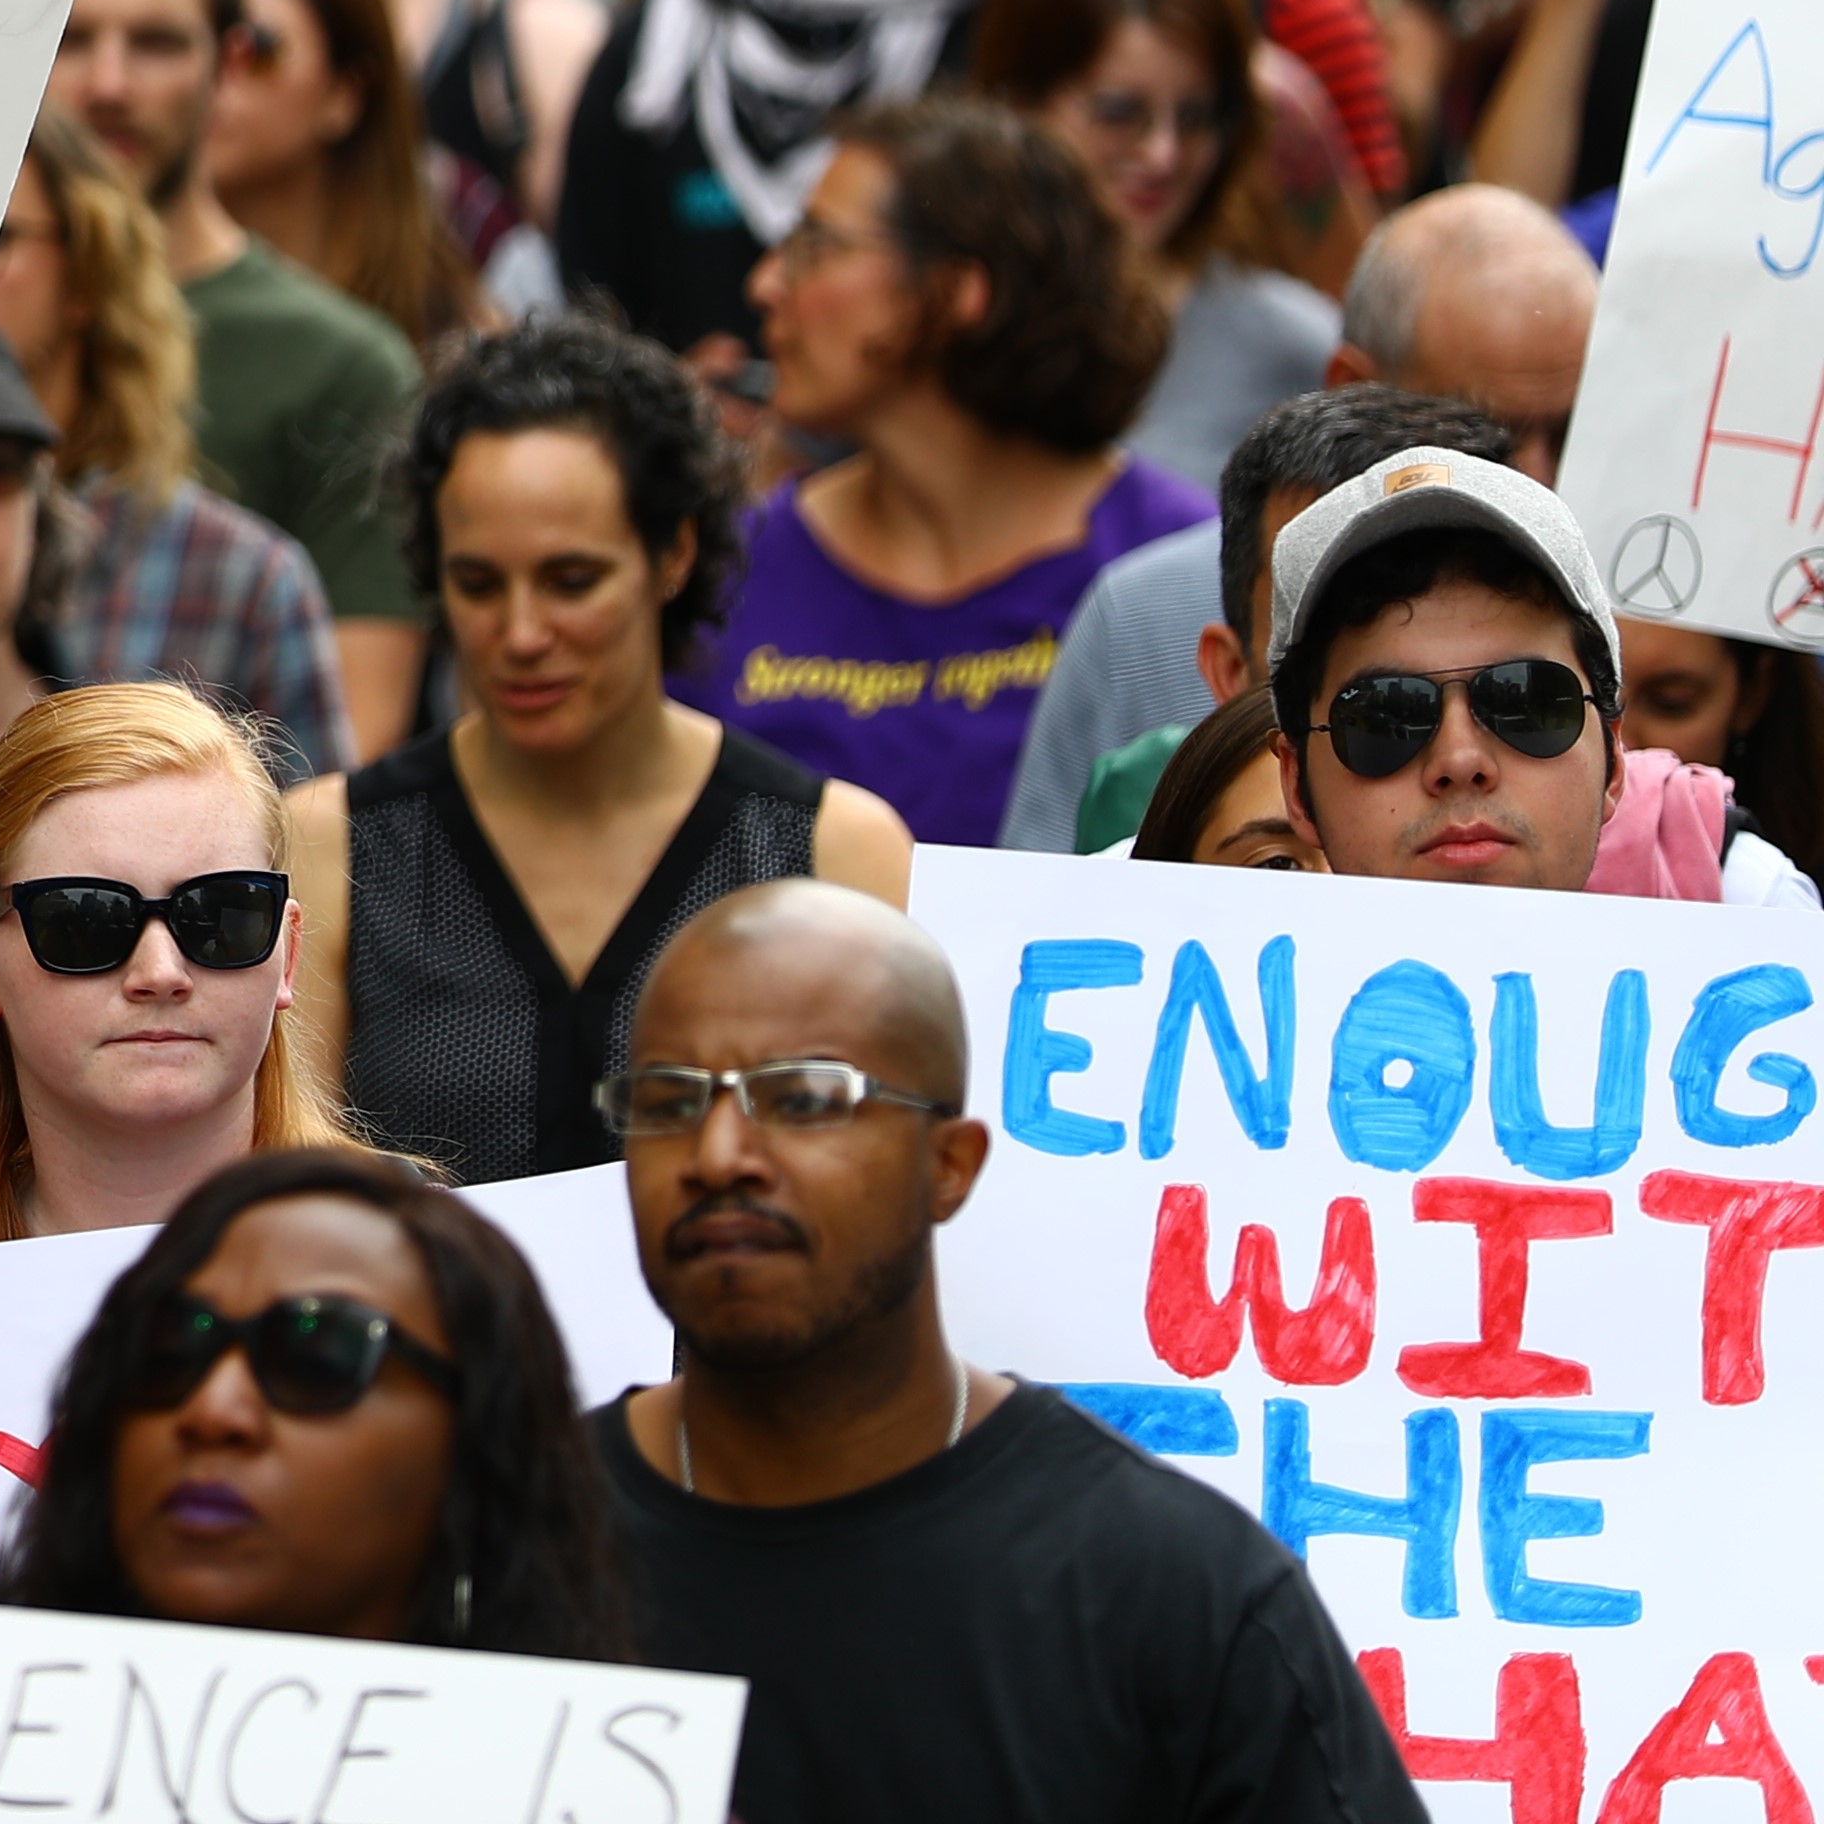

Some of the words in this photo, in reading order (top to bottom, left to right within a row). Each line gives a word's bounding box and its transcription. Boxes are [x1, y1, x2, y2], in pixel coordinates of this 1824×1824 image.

[1691, 332, 1824, 534] H
[1002, 933, 1818, 1177] ENOUG
[1145, 1168, 1824, 1406] WIT
[538, 1699, 683, 1824] IS
